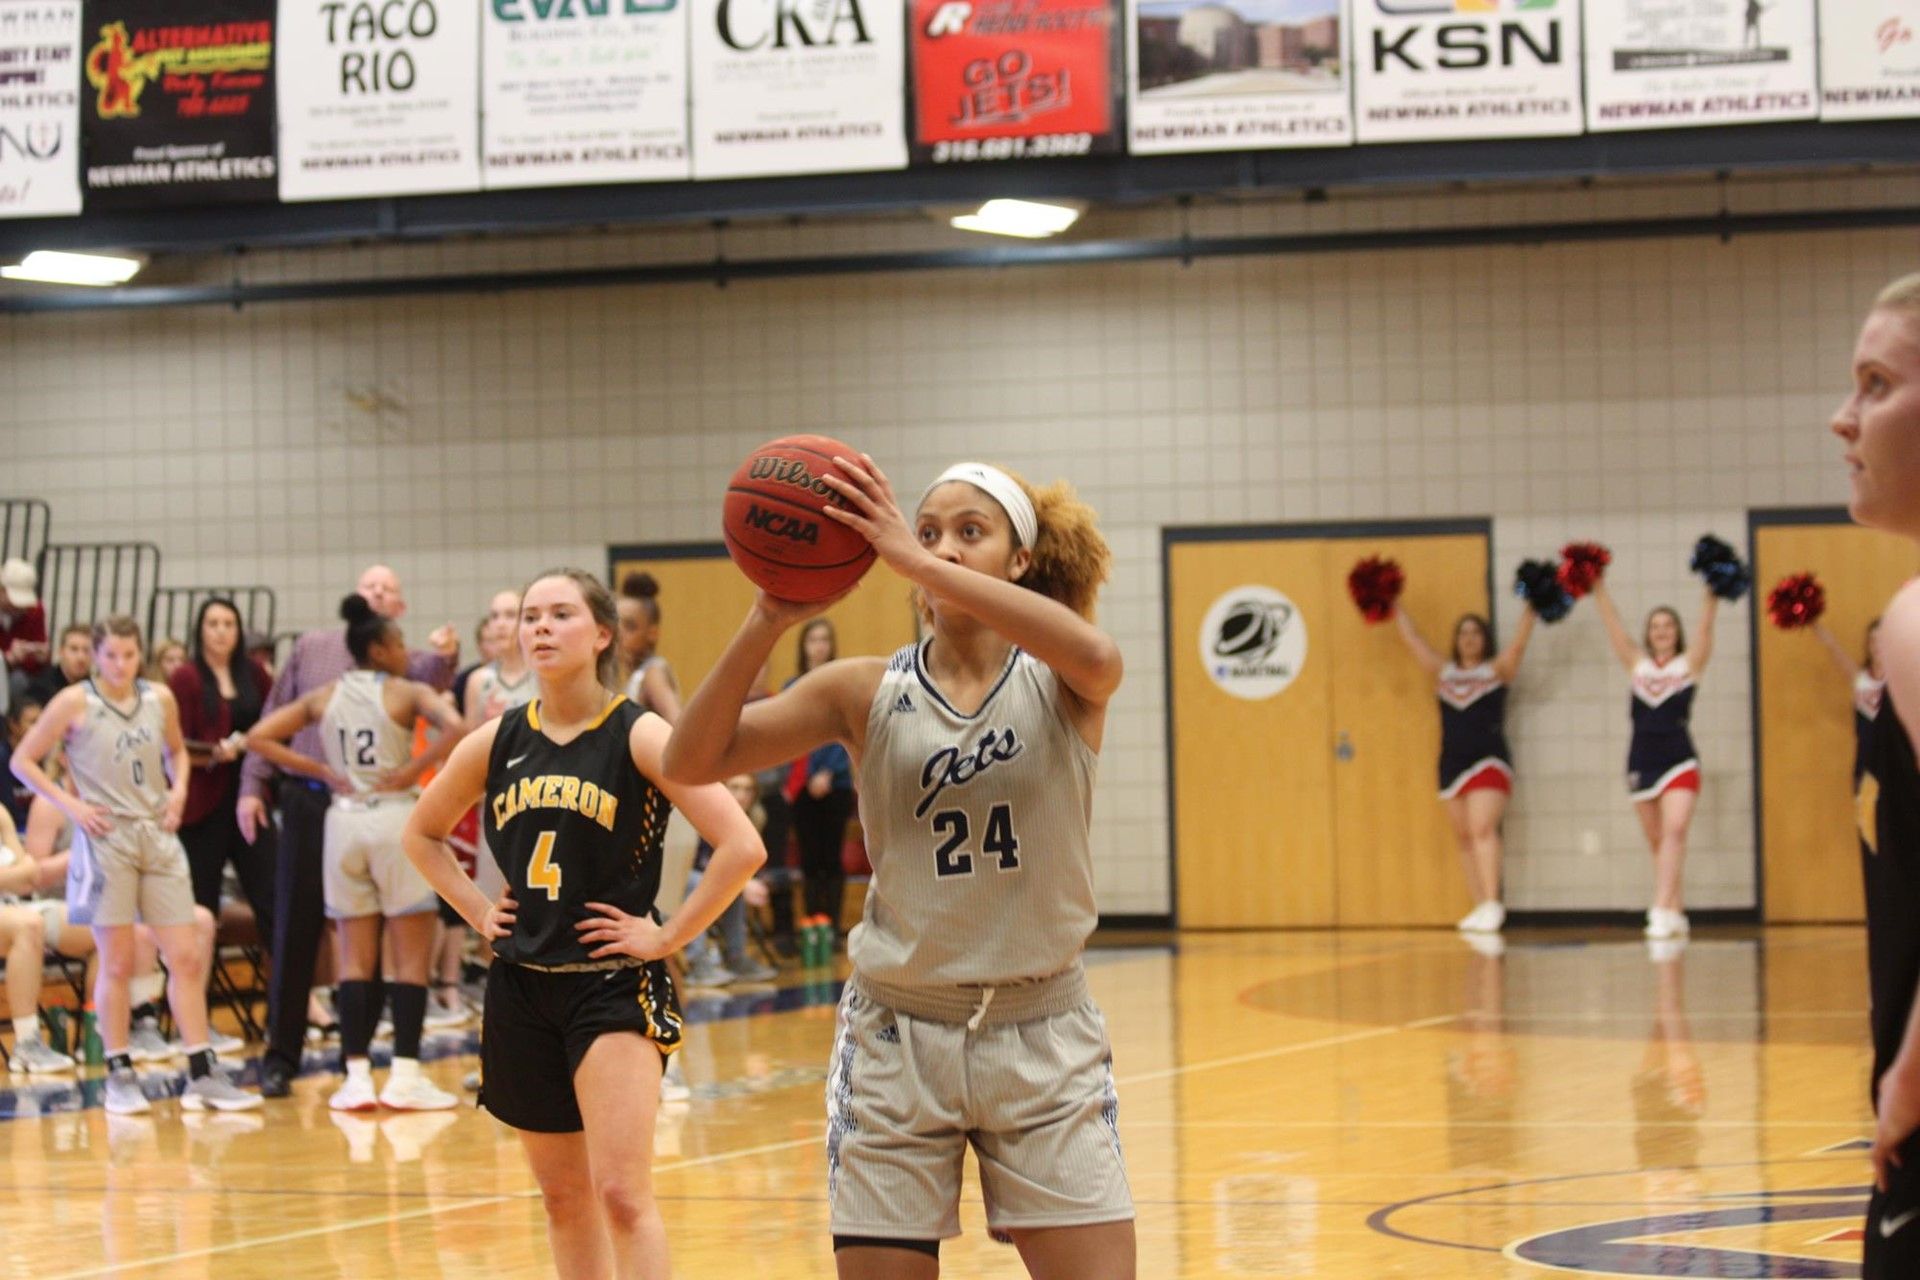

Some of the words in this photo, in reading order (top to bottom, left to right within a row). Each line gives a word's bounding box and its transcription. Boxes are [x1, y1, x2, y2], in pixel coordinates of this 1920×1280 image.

[131, 20, 271, 53] ALTERNATIVE
[319, 0, 438, 43] TACO
[1372, 19, 1561, 73] KSN
[341, 50, 416, 94] RIO
[963, 50, 1032, 91] GO
[1368, 105, 1460, 120] NEWMAN
[1467, 98, 1571, 117] ATHLETICS
[1599, 102, 1695, 119] NEWMAN
[1702, 91, 1811, 113] ATHLETICS
[1136, 122, 1228, 139] NEWMAN
[1235, 117, 1346, 135] ATHLETICS
[87, 162, 172, 188] NEWMAN
[173, 155, 277, 182] ATHLETICS
[488, 150, 574, 167] NEWMAN
[581, 144, 689, 163] ATHLETICS
[745, 503, 820, 546] NCAA
[338, 728, 376, 766] 12
[132, 759, 144, 786] 0
[915, 726, 1025, 821] Jets
[492, 774, 619, 832] CAMERON
[931, 801, 1022, 881] 24
[527, 831, 562, 901] 4
